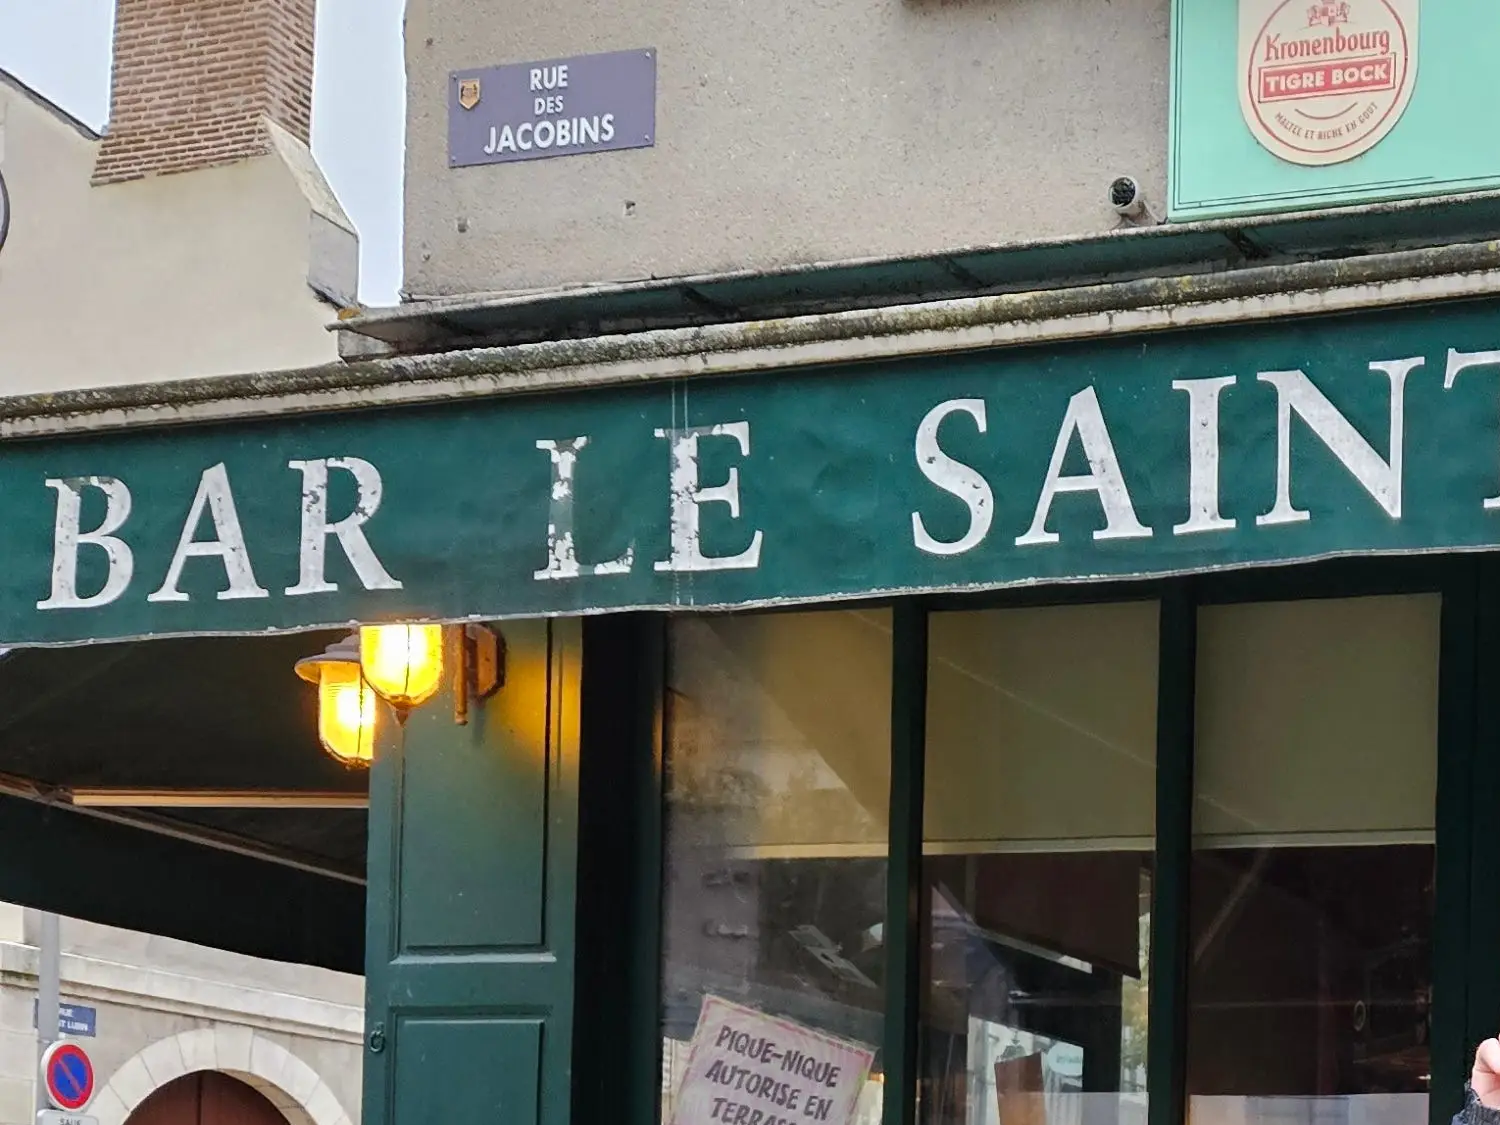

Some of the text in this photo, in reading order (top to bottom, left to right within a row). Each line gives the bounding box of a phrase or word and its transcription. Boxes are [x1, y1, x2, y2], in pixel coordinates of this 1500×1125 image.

[1264, 27, 1390, 62] Kronenbourg
[530, 65, 569, 91] RUE
[1266, 64, 1388, 93] TIGRE BOCK
[535, 95, 564, 116] DES
[484, 113, 615, 154] JACOBINS
[37, 455, 404, 610] BAR
[534, 421, 763, 580] LE
[715, 1025, 841, 1088] PIQUE-NIQUE
[705, 1060, 834, 1121] AUTORISE EN
